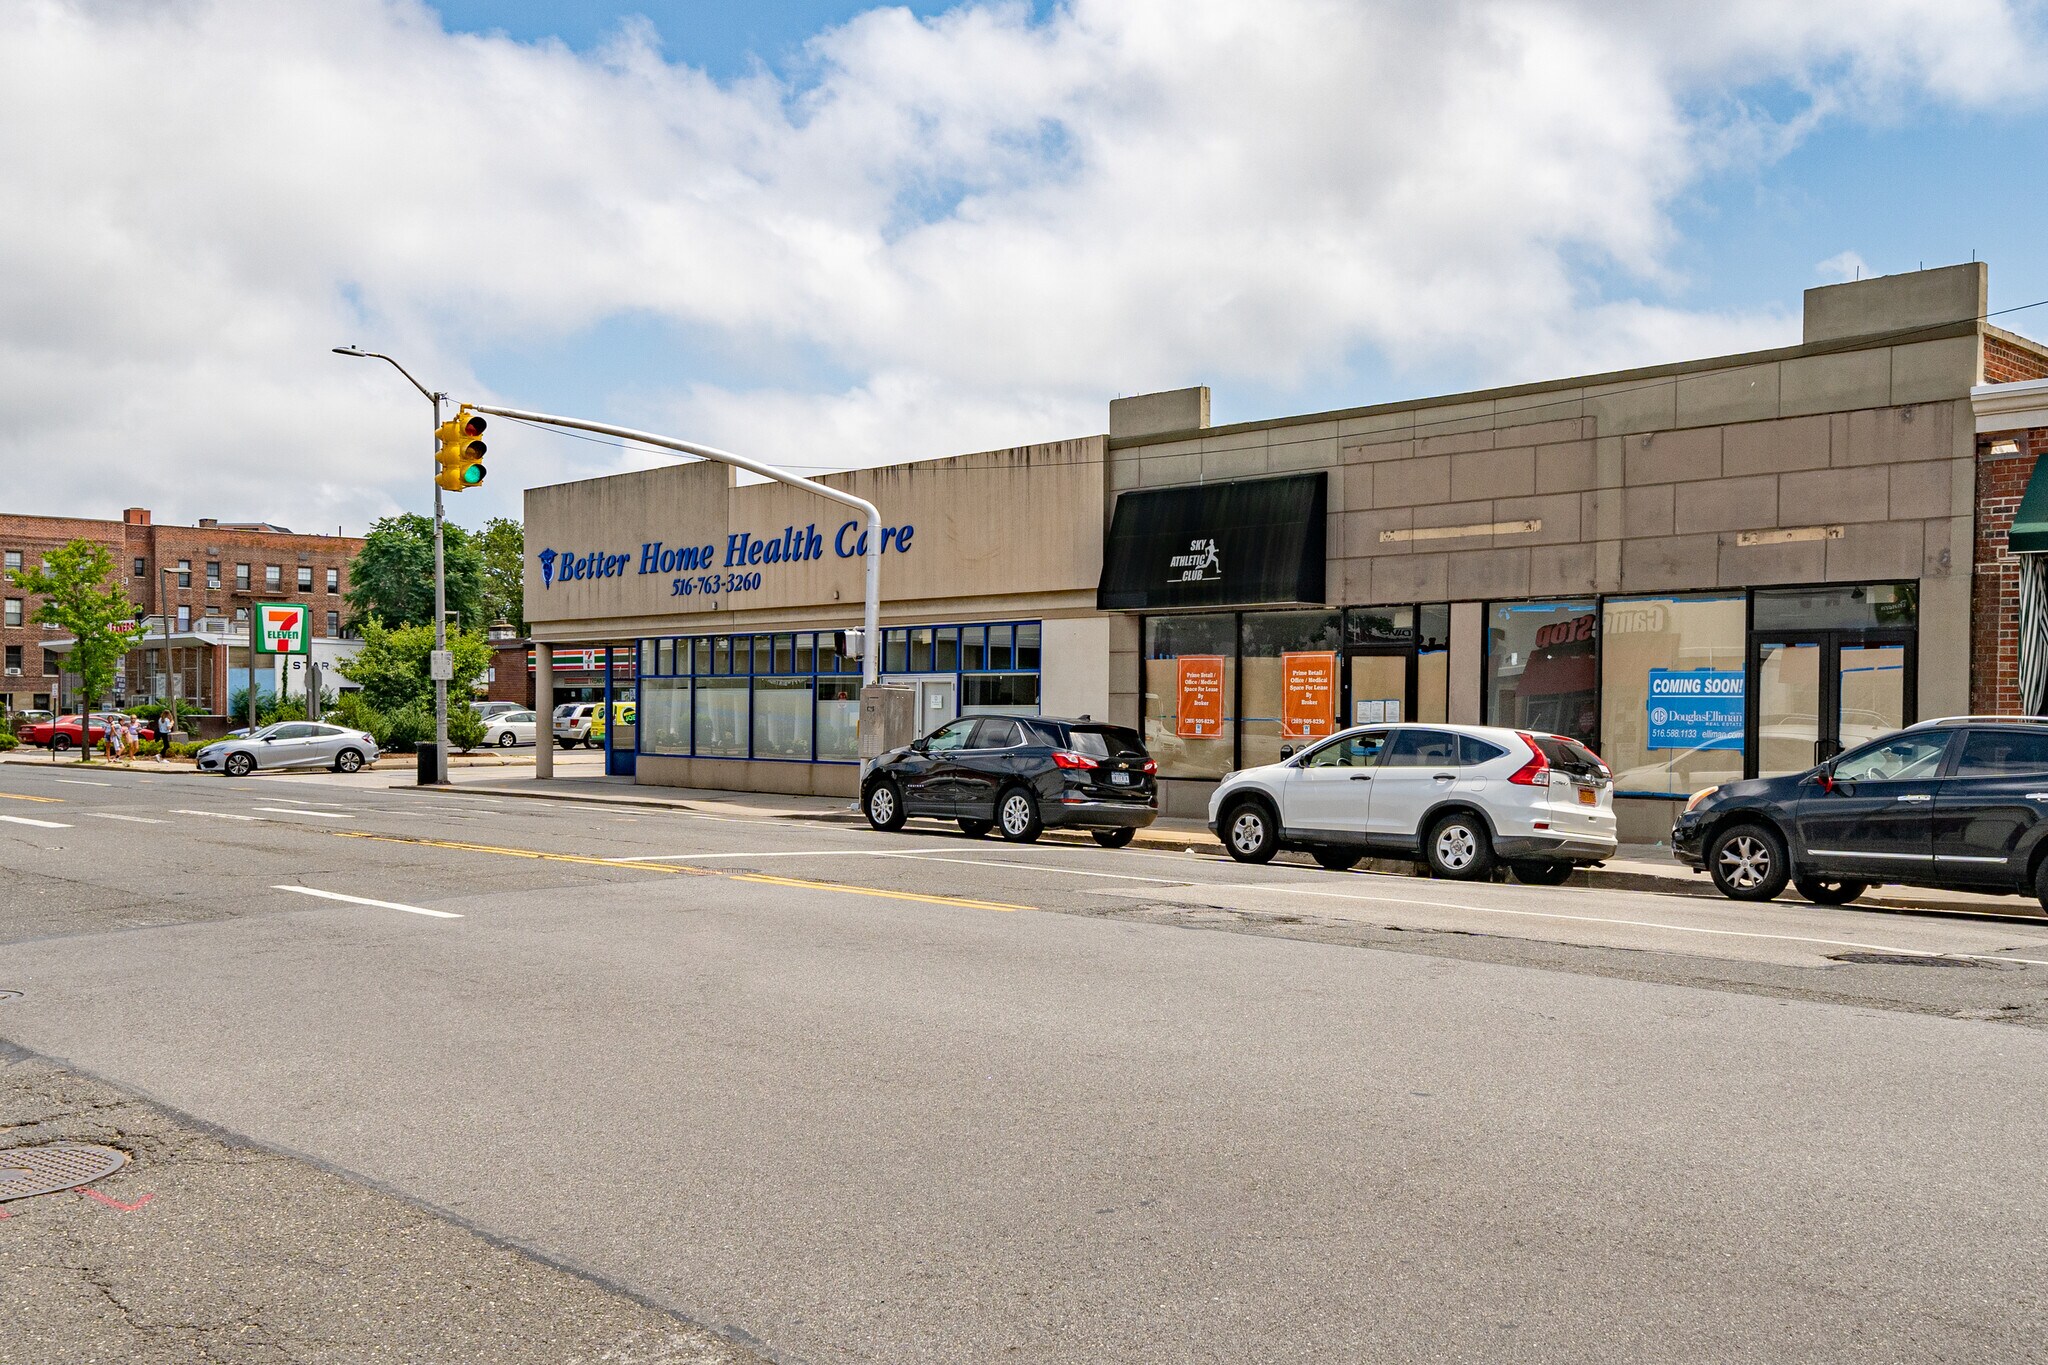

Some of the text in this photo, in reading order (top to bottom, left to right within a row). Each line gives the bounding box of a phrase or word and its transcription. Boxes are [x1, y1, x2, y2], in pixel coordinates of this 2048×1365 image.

[1190, 539, 1207, 551] SKY
[558, 551, 630, 582] Better
[638, 542, 714, 576] Home
[723, 524, 823, 568] Health
[1170, 554, 1206, 568] ATHLETIC
[1182, 570, 1204, 582] CLUB
[670, 572, 762, 597] 516-763-3260
[1653, 679, 1744, 693] COMING SOON!
[1652, 729, 1744, 738] 516.588.1133 elliman.com
